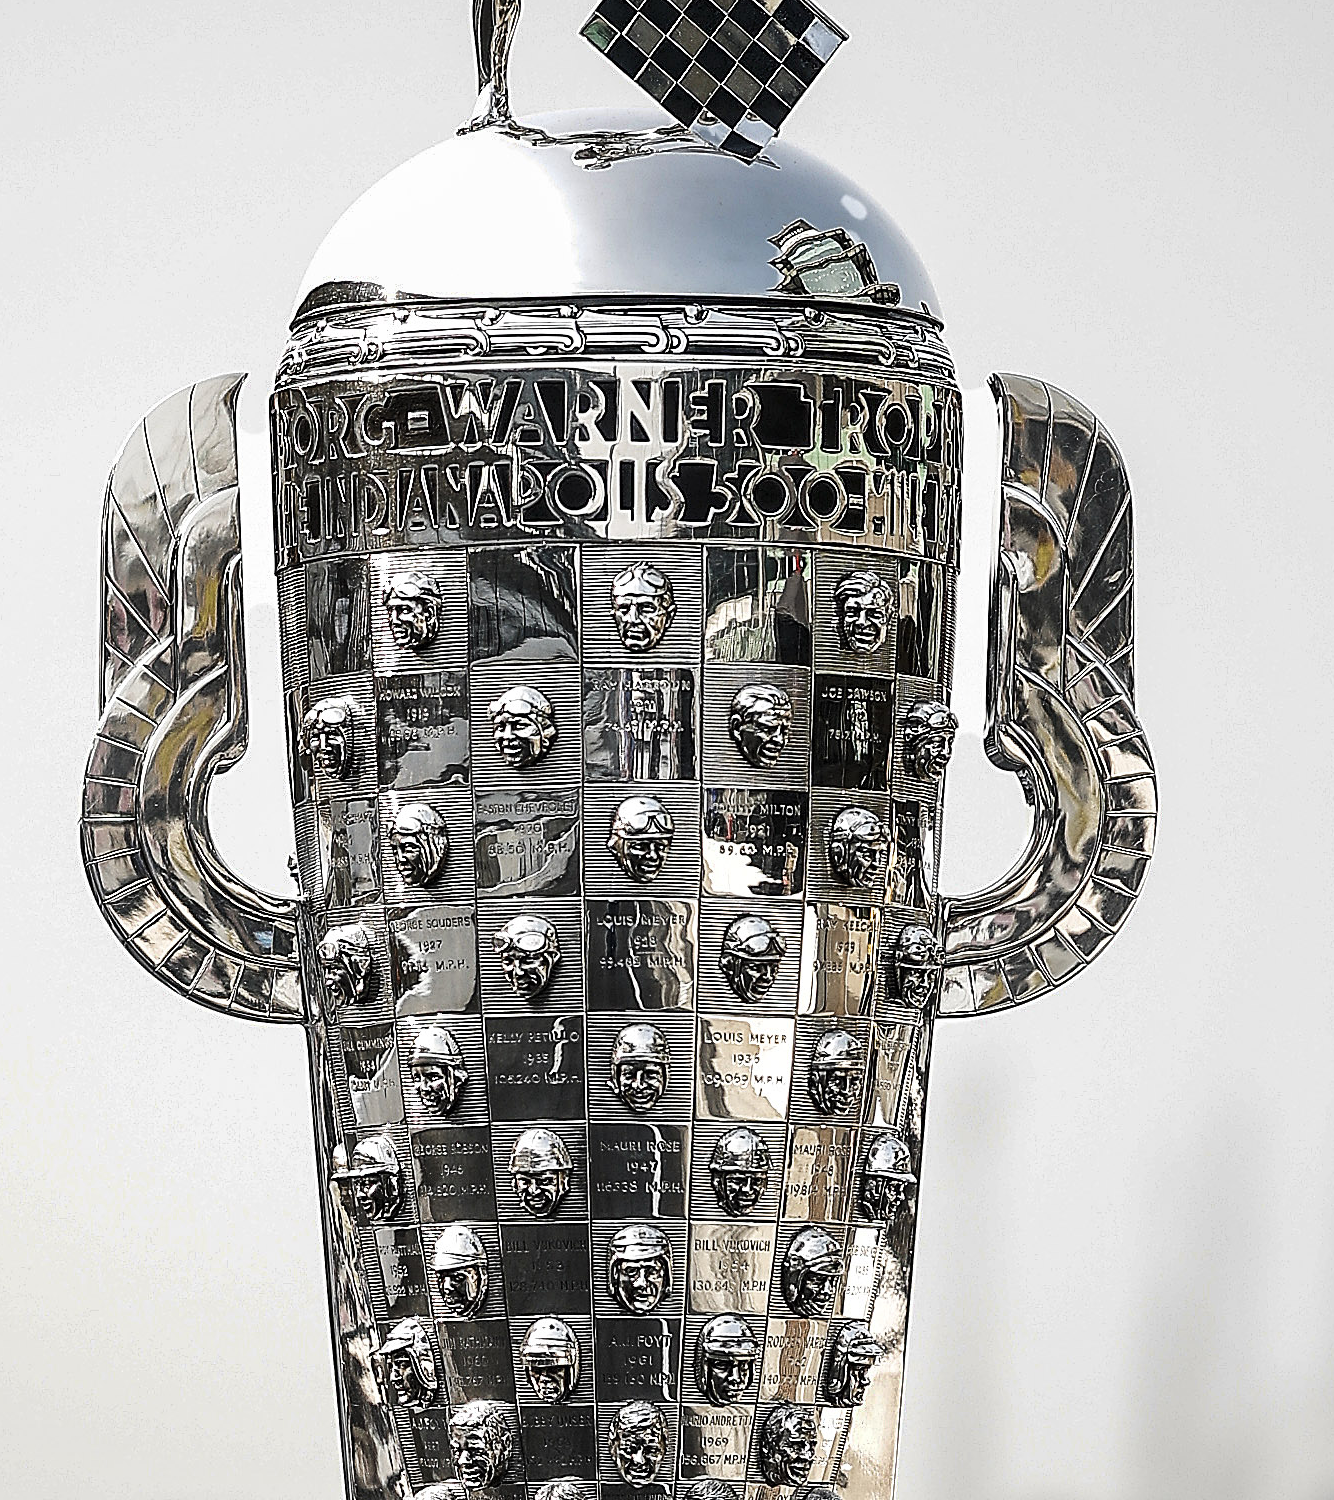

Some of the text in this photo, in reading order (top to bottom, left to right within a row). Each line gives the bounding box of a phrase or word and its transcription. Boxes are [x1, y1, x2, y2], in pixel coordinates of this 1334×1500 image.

[317, 457, 683, 543] INDIANAPOLIS
[821, 687, 843, 699] JOE
[760, 804, 801, 816] MILTON
[427, 916, 471, 929] SOUDERS
[596, 913, 686, 927] LOUIS MEYER
[418, 940, 443, 953] 1927
[488, 1032, 524, 1044] KELLY
[704, 1031, 787, 1045] LOUIS MEYER
[600, 1141, 680, 1153] MAURI ROSE
[793, 1144, 826, 1156] MAURI
[506, 1240, 587, 1253] BILL VUKOVICH
[694, 1239, 771, 1252] BILL VUKOVICH
[718, 1260, 750, 1272] 1954
[637, 1334, 672, 1348] FOYT
[709, 1415, 753, 1427] ANDRETTI
[702, 1437, 729, 1449] 1969
